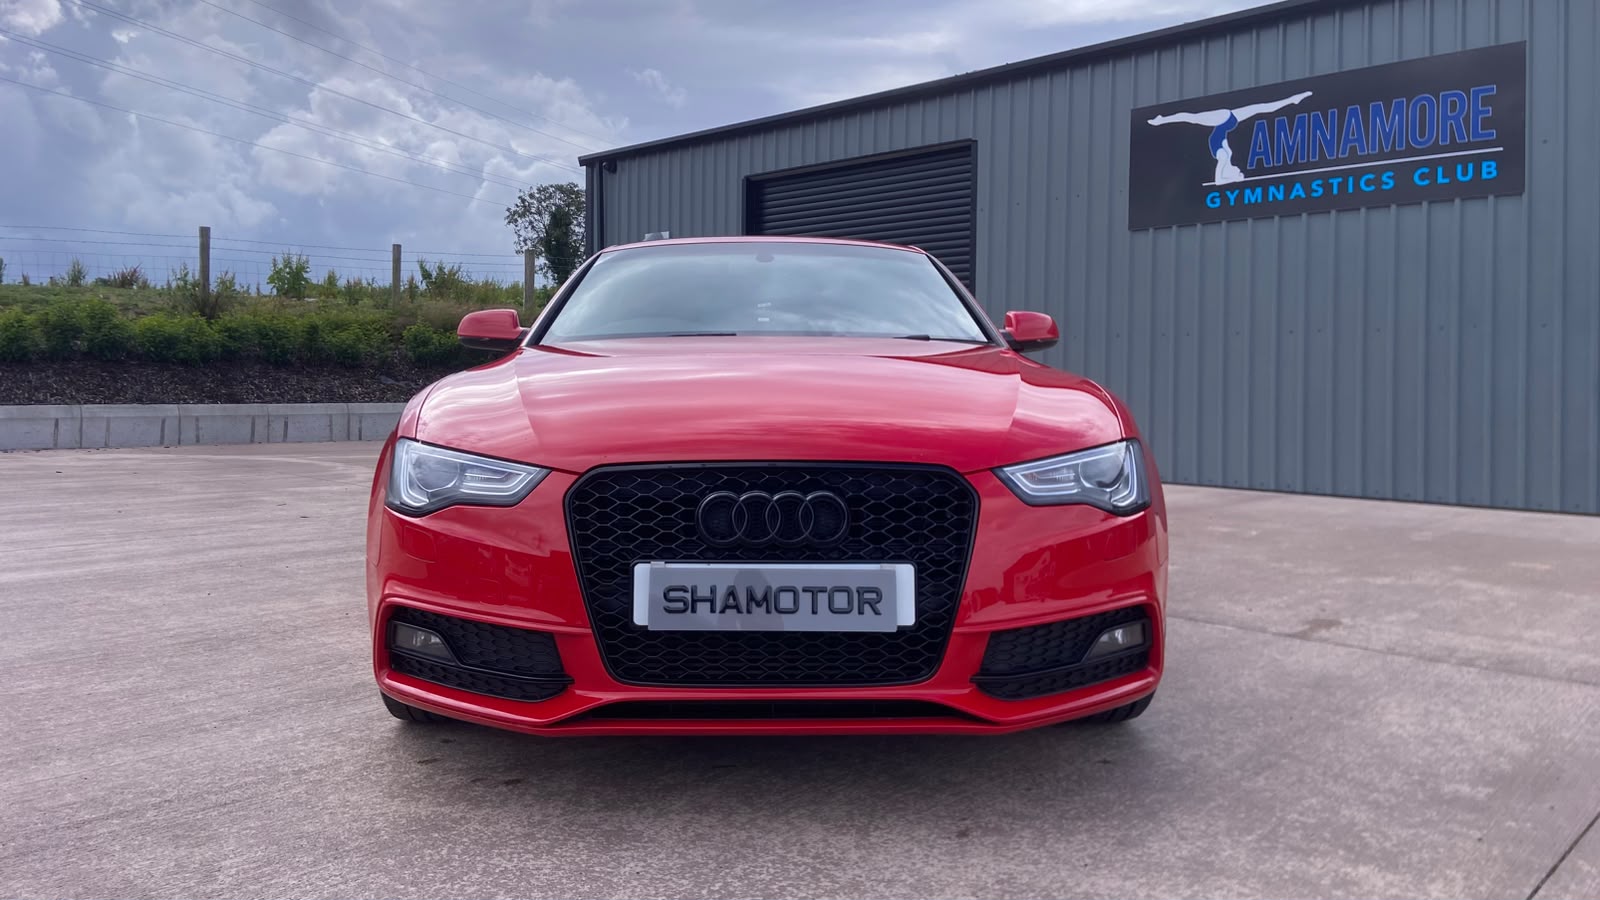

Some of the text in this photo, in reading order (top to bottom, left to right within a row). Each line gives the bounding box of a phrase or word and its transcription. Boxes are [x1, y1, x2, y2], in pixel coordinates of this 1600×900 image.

[1205, 160, 1499, 208] GYMNASTICS CLUB
[663, 584, 882, 615] SHAMOTOR
